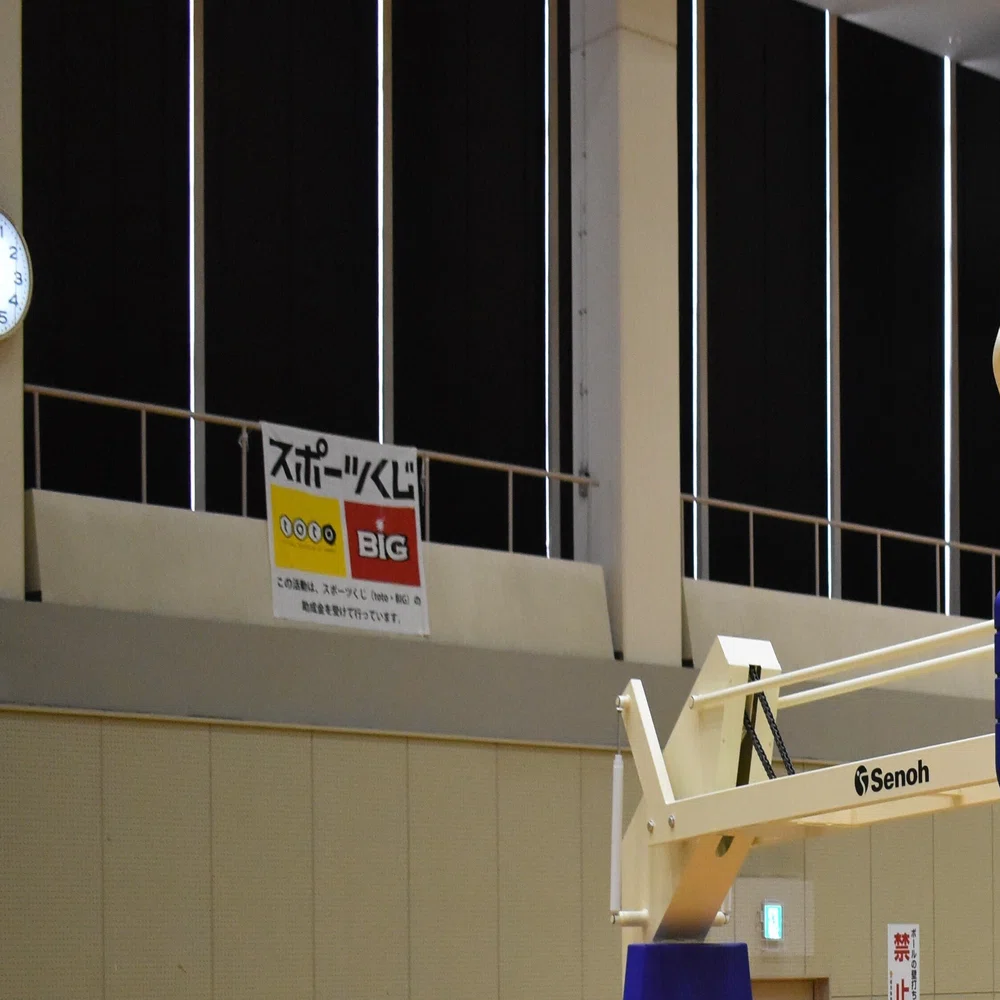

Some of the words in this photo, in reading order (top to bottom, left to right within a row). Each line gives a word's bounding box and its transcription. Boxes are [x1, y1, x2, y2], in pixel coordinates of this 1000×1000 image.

[10, 246, 17, 260] 2
[14, 271, 22, 285] 3
[8, 294, 18, 306] 4
[0, 311, 7, 324] 5
[269, 438, 415, 500] スポーツくじ
[279, 514, 337, 546] toto
[357, 526, 409, 562] BIG
[871, 759, 929, 792] Senoh
